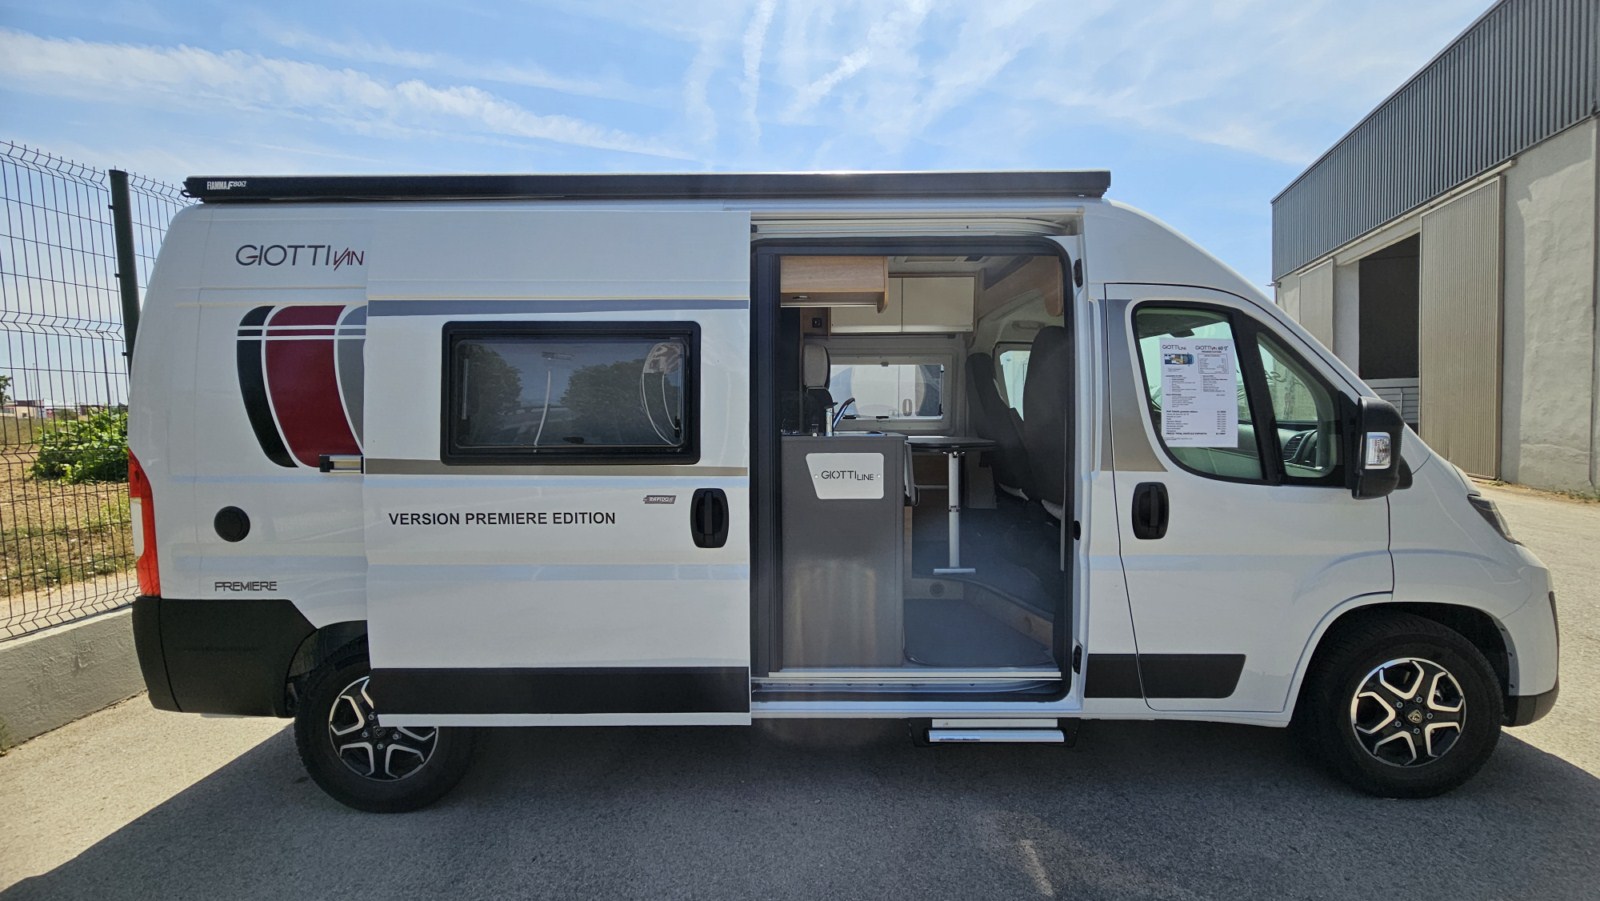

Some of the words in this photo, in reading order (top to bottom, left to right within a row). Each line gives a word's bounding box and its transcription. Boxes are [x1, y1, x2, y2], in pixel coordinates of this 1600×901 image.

[388, 512, 460, 525] VERSION
[465, 512, 548, 525] PREMIERE
[552, 512, 616, 525] EDITION
[214, 581, 278, 592] PREMIERE
